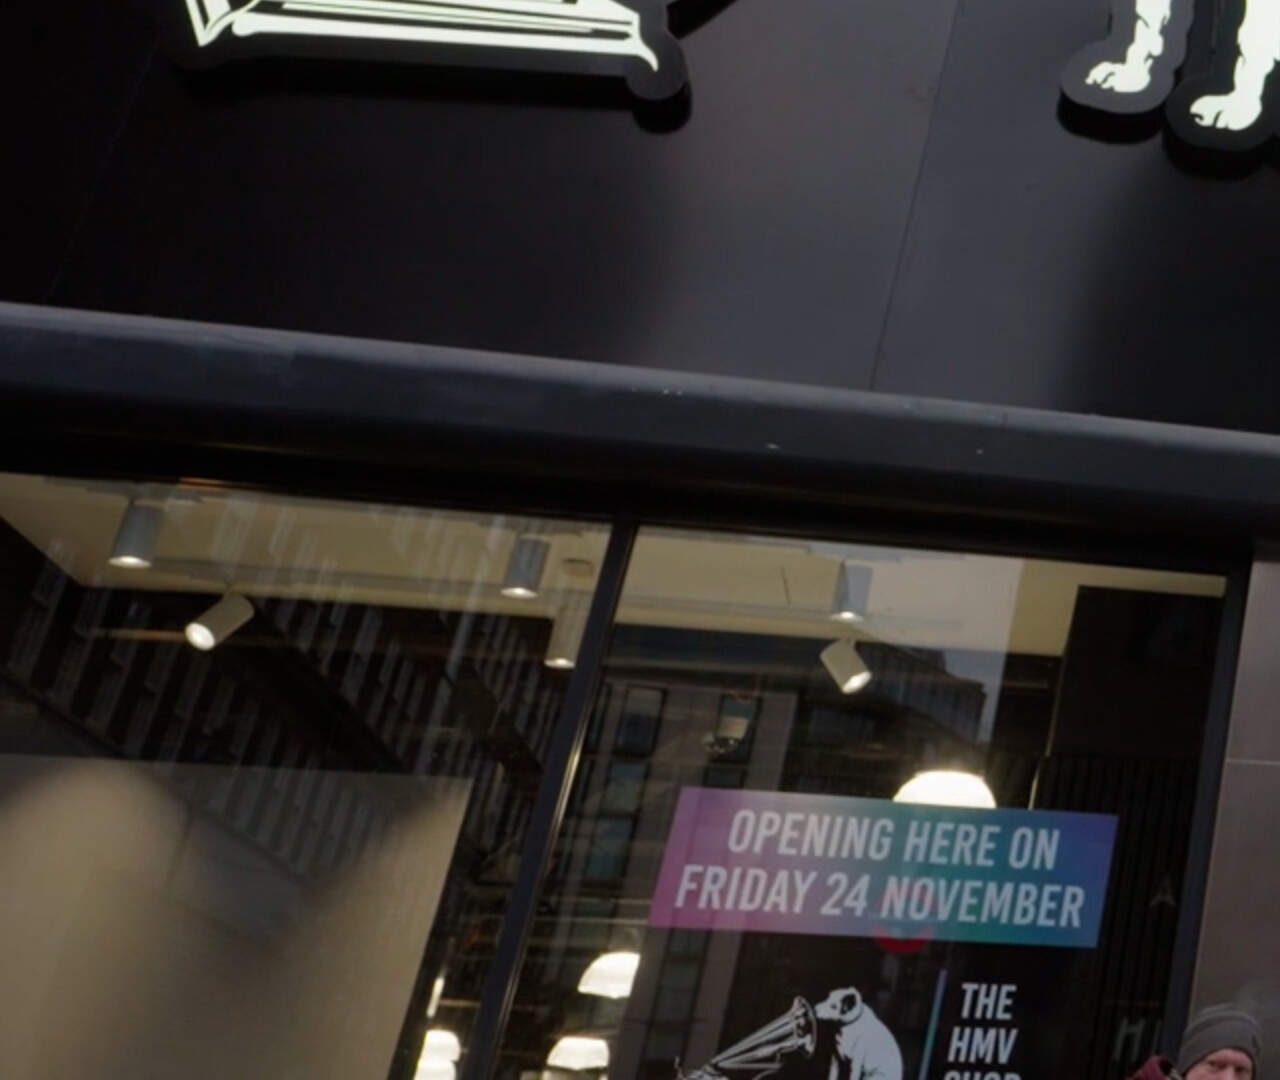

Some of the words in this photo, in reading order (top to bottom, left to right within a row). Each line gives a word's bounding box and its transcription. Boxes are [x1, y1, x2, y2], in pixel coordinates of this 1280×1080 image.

[727, 809, 896, 861] OPENING
[903, 820, 1001, 867] HERE
[1007, 826, 1060, 871] ON
[675, 864, 816, 913] FRIDAY
[819, 872, 868, 917] 24
[880, 875, 1085, 929] NOVEMBER
[962, 983, 1017, 1020] THE
[948, 1026, 1018, 1064] HMV
